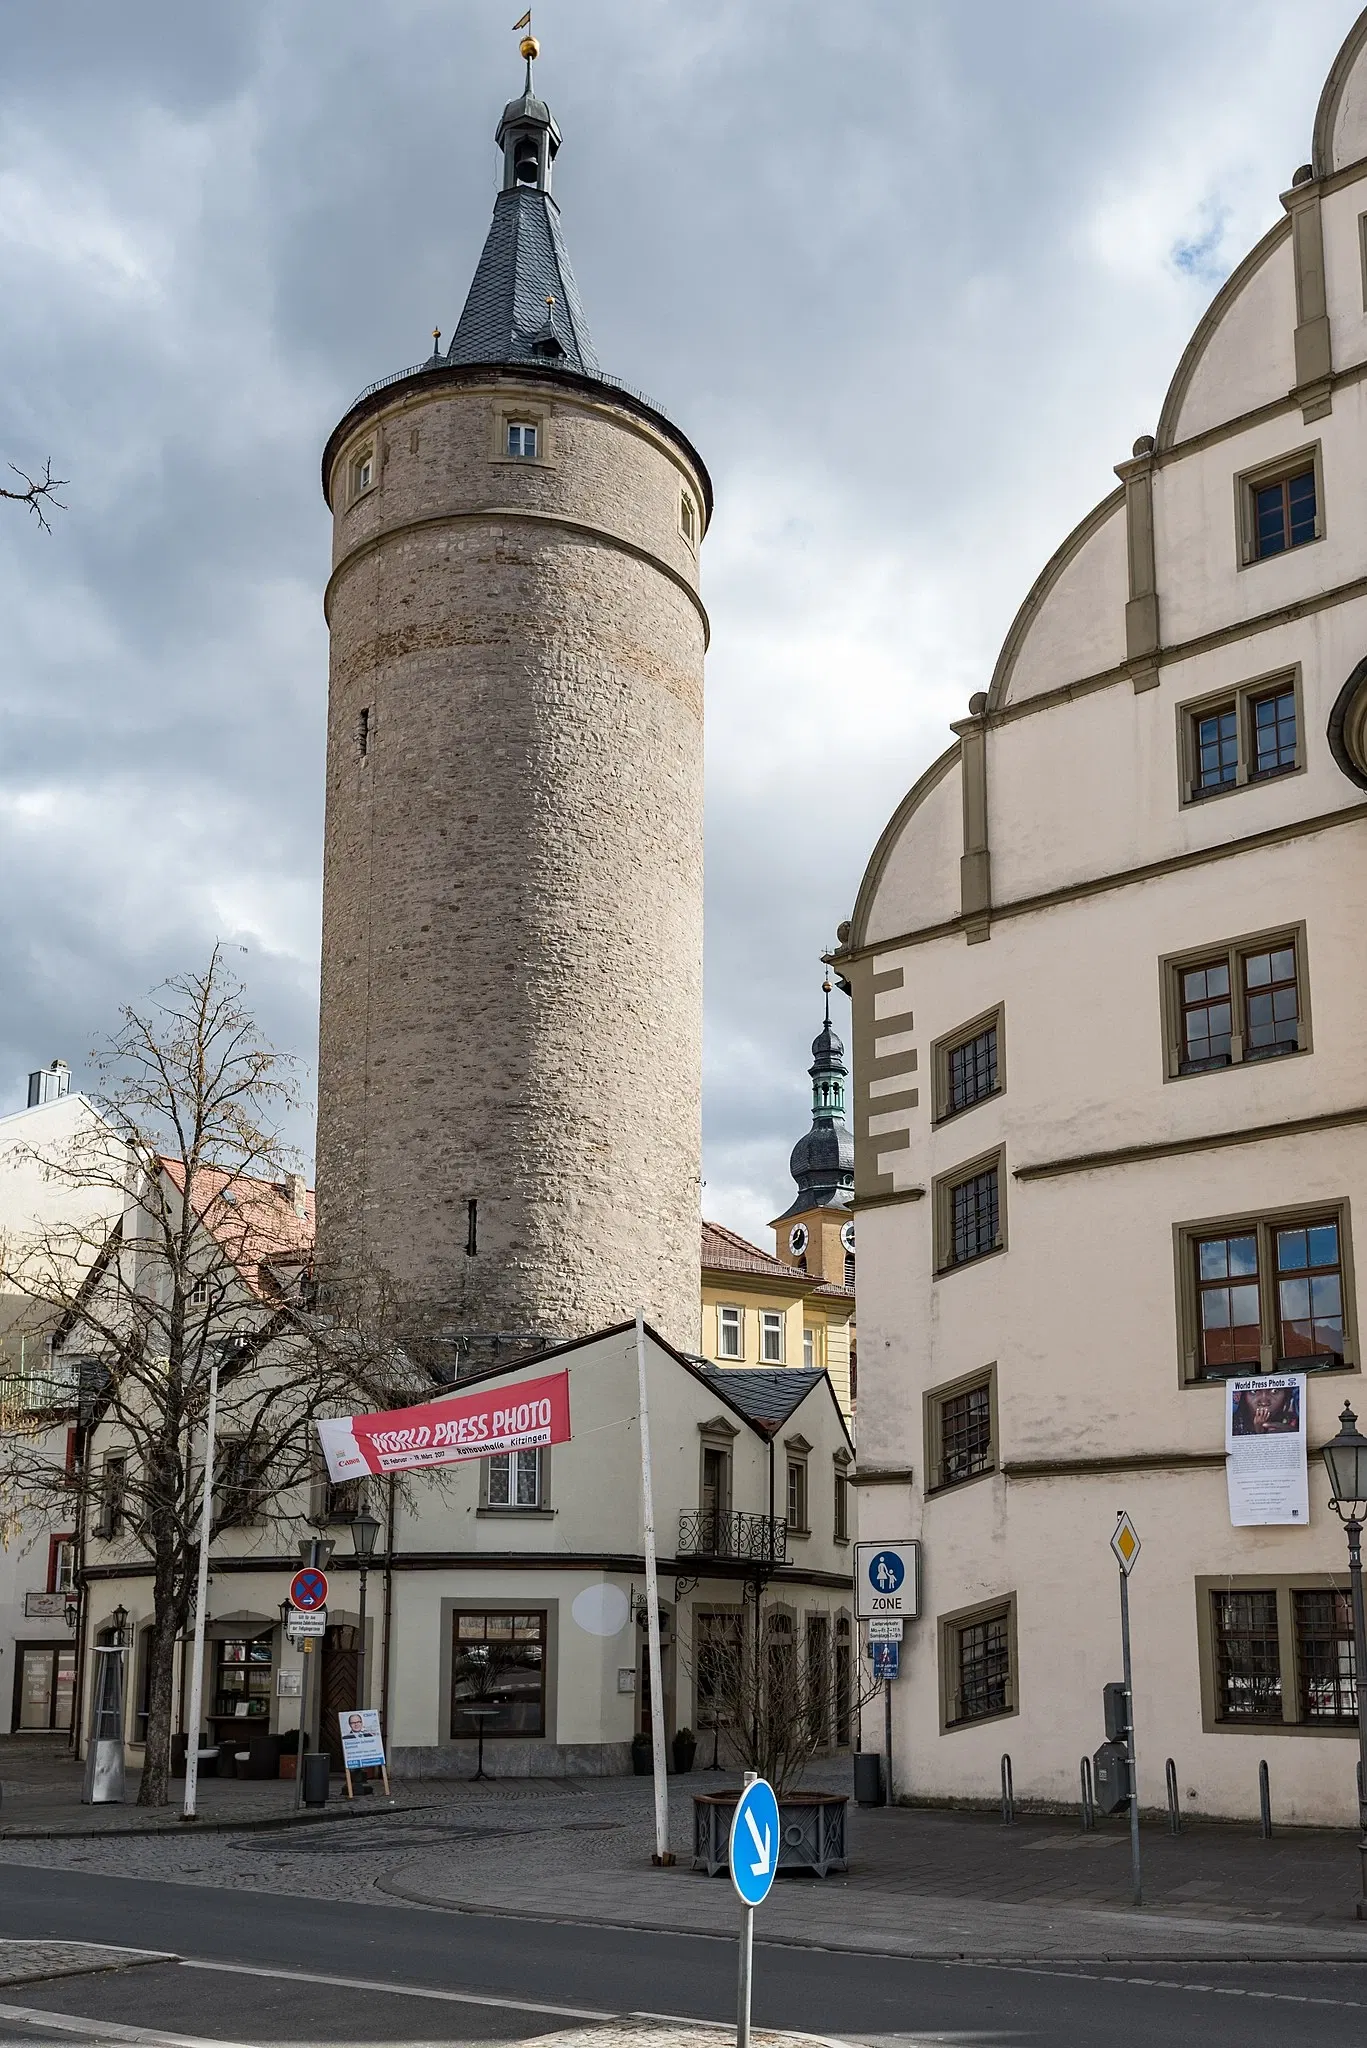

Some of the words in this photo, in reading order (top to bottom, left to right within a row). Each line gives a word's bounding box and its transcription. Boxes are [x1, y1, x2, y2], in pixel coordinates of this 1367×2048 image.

[1234, 1381, 1251, 1390] World
[1251, 1380, 1268, 1389] Press
[1268, 1379, 1286, 1388] Photo
[365, 1426, 431, 1453] WORLD
[432, 1413, 488, 1446] PRESS
[492, 1398, 551, 1436] PHOTO
[456, 1441, 505, 1455] Rathaushalle
[510, 1433, 547, 1447] Kitzingen
[338, 1458, 360, 1468] Canon
[872, 1597, 902, 1610] ZONE
